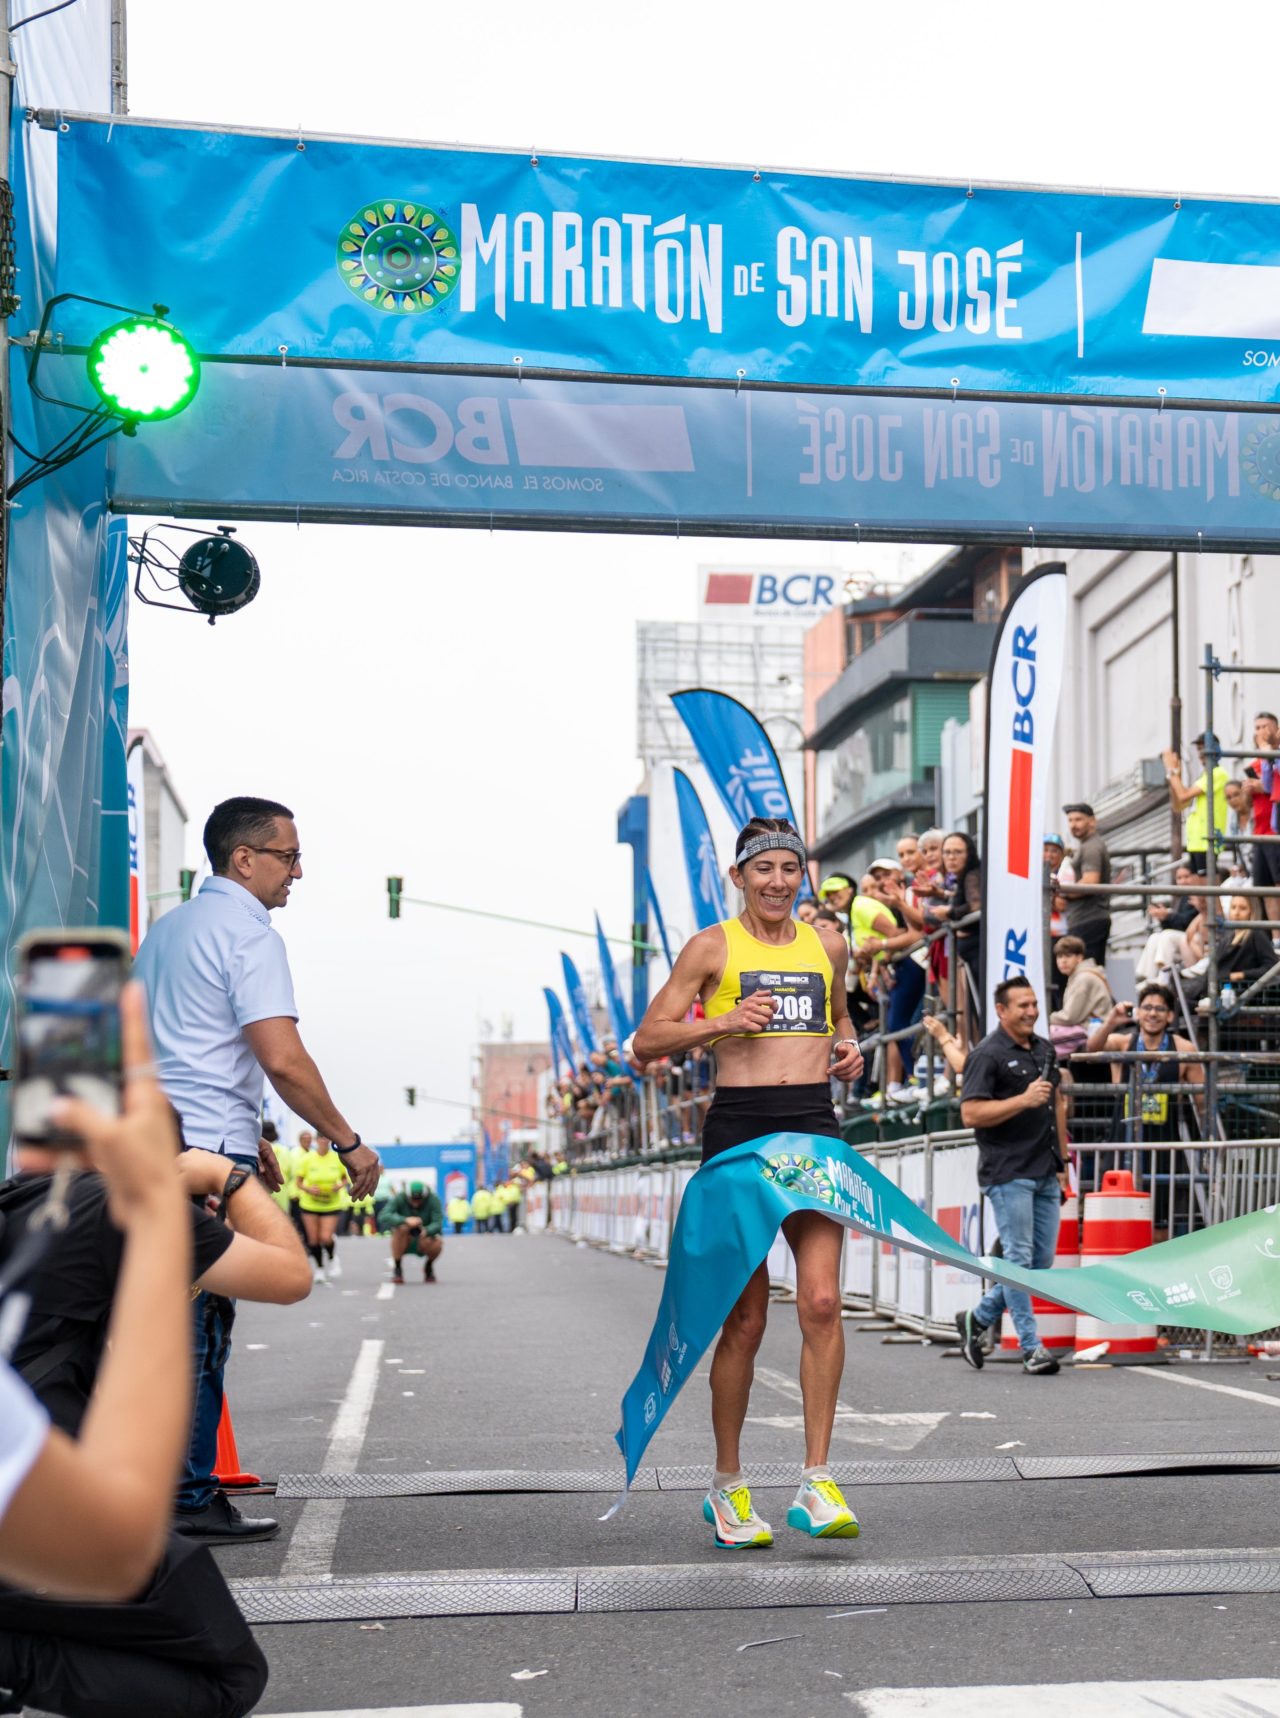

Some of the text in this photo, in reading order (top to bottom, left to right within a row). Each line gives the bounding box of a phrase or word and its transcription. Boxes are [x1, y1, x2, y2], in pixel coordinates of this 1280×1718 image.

[460, 202, 1024, 339] MARATÓN DE SAN JOSÉ
[757, 574, 834, 605] BCR
[1011, 624, 1037, 745] BCR
[771, 995, 813, 1020] 208
[826, 1156, 875, 1221] MARATÓN
